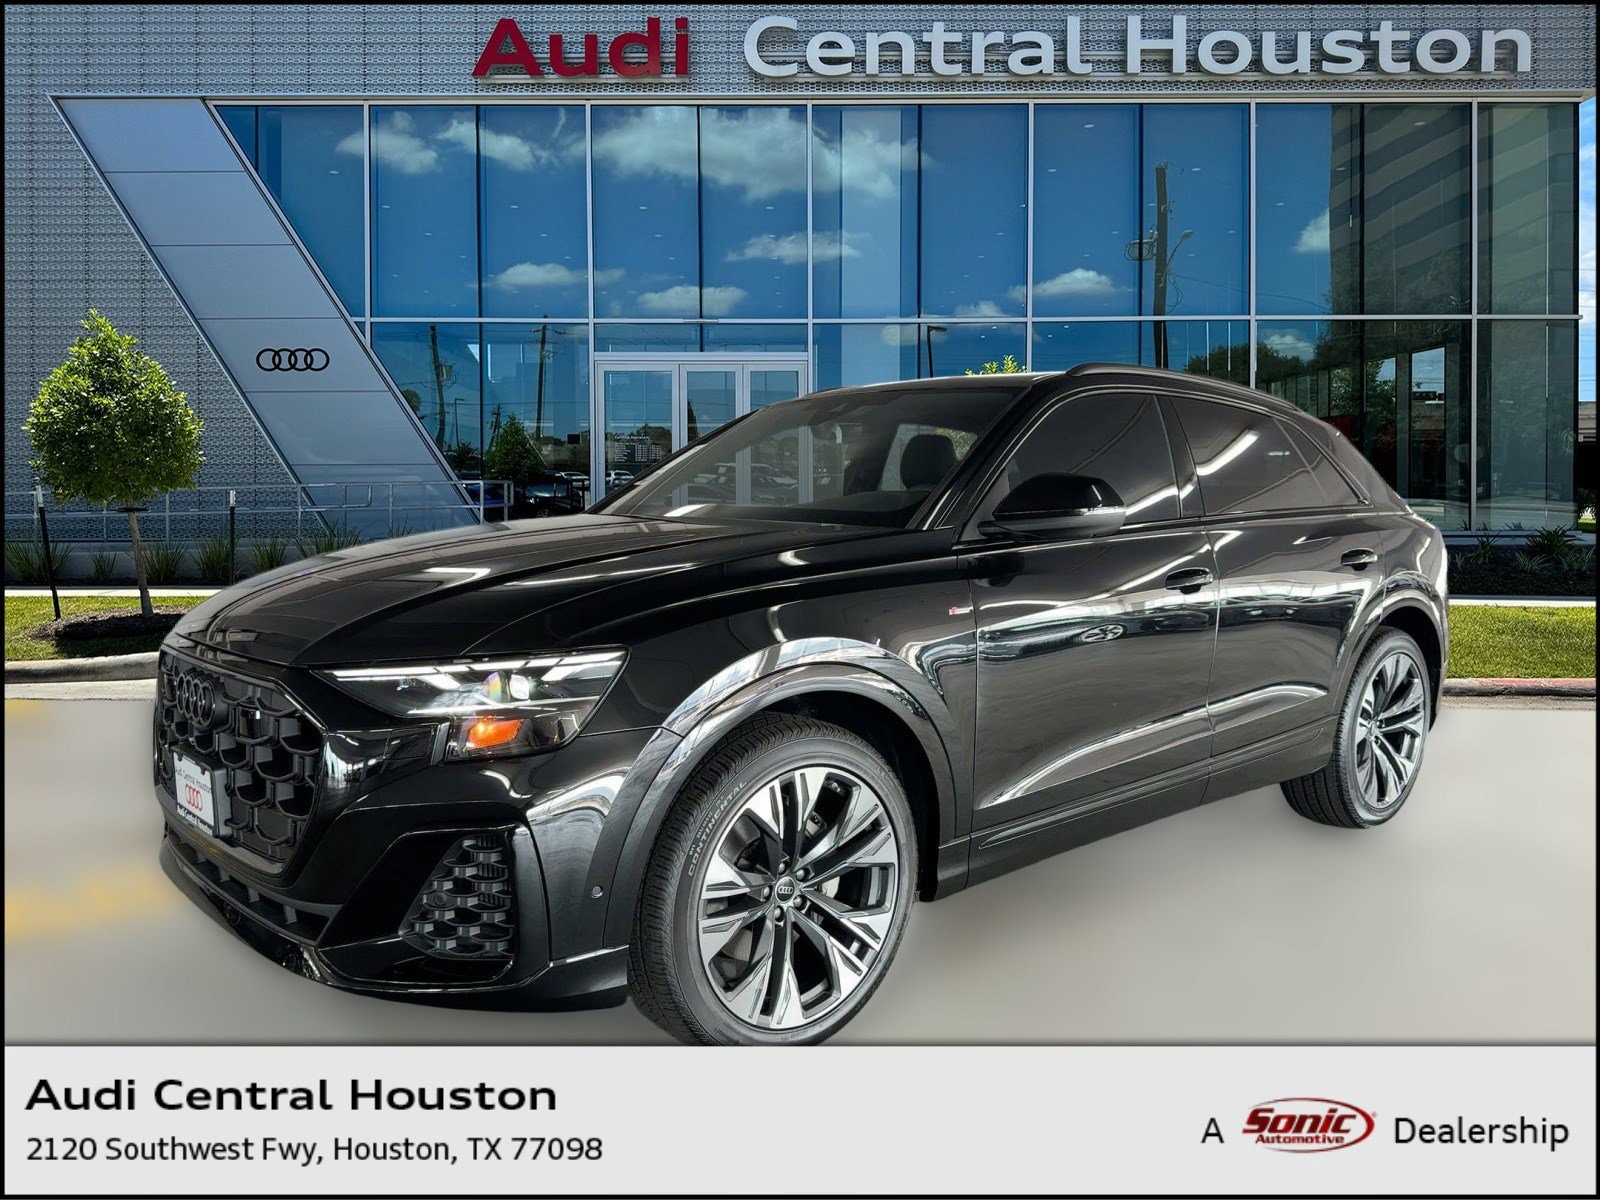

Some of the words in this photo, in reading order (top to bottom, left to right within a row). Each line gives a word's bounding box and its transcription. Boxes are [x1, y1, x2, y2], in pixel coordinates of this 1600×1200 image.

[471, 17, 689, 77] Audi
[743, 15, 1093, 77] Central
[1126, 15, 1532, 75] Houston
[688, 782, 748, 877] CONTINENTAL
